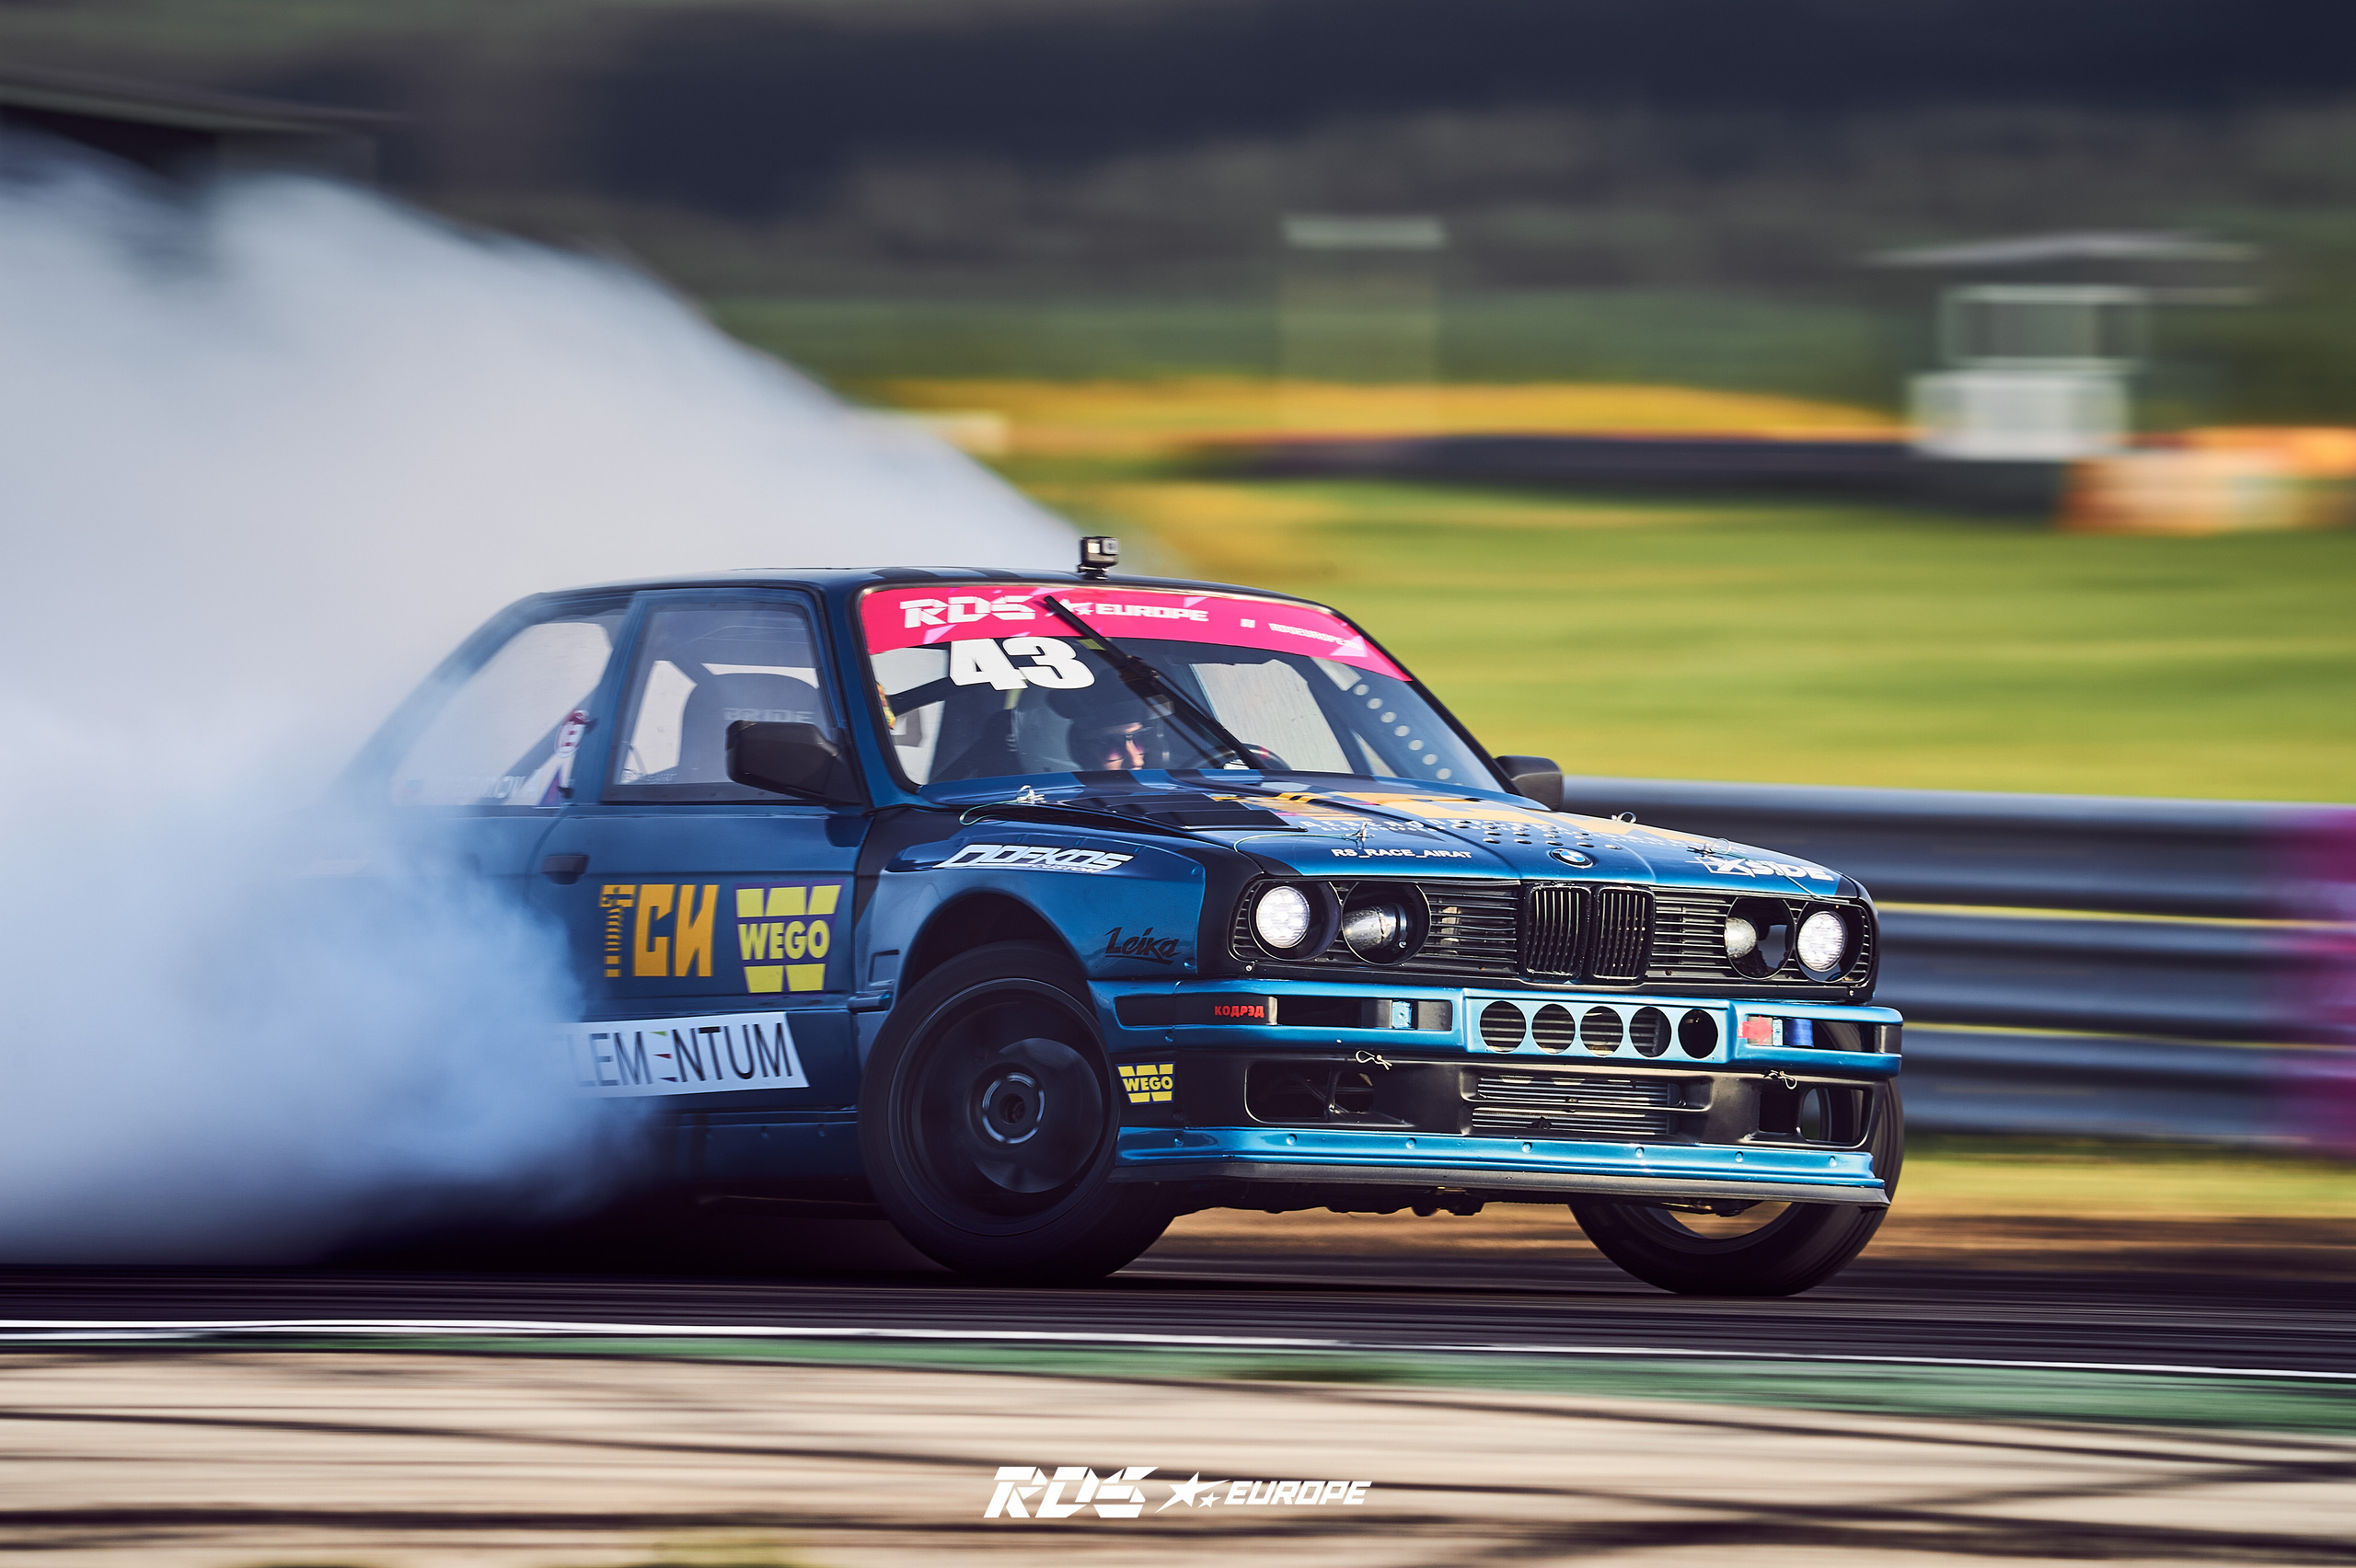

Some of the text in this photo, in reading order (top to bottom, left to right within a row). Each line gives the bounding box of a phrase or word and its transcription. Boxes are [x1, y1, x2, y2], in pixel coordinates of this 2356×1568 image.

[900, 596, 1209, 628] RDS EUROPE
[950, 637, 1095, 691] 43
[1331, 848, 1472, 859] RS_RACE_AIRAT
[738, 919, 830, 961] WEGO
[1105, 927, 1182, 965] Leika
[1214, 1005, 1265, 1019] КОДРЭД
[552, 1022, 793, 1088] LEMENTUM
[1122, 1076, 1173, 1092] WEGO
